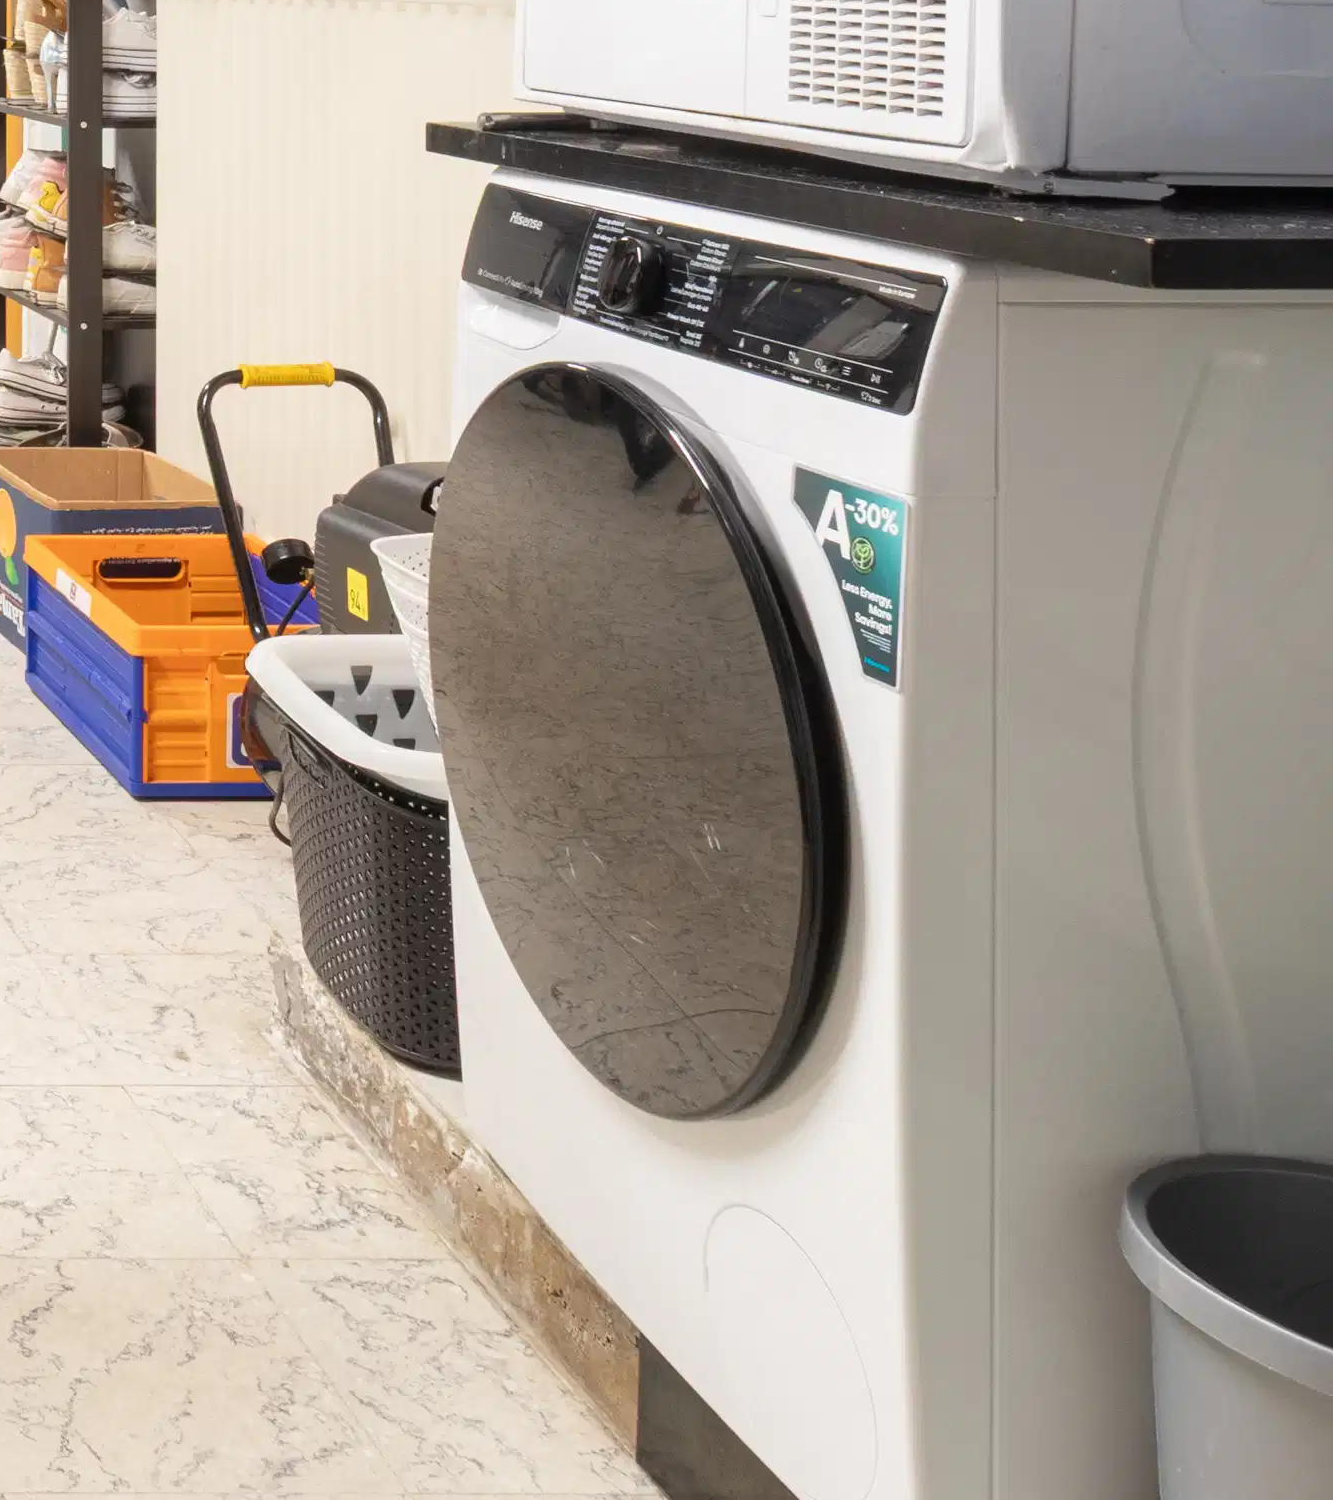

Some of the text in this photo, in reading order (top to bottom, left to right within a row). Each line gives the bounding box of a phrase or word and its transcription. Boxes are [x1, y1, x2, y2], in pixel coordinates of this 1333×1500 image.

[509, 211, 543, 231] Hisense
[815, 488, 852, 561] A
[845, 497, 899, 536] -30%
[841, 579, 860, 596] Less
[868, 603, 893, 621] More
[854, 611, 893, 636] Savings!
